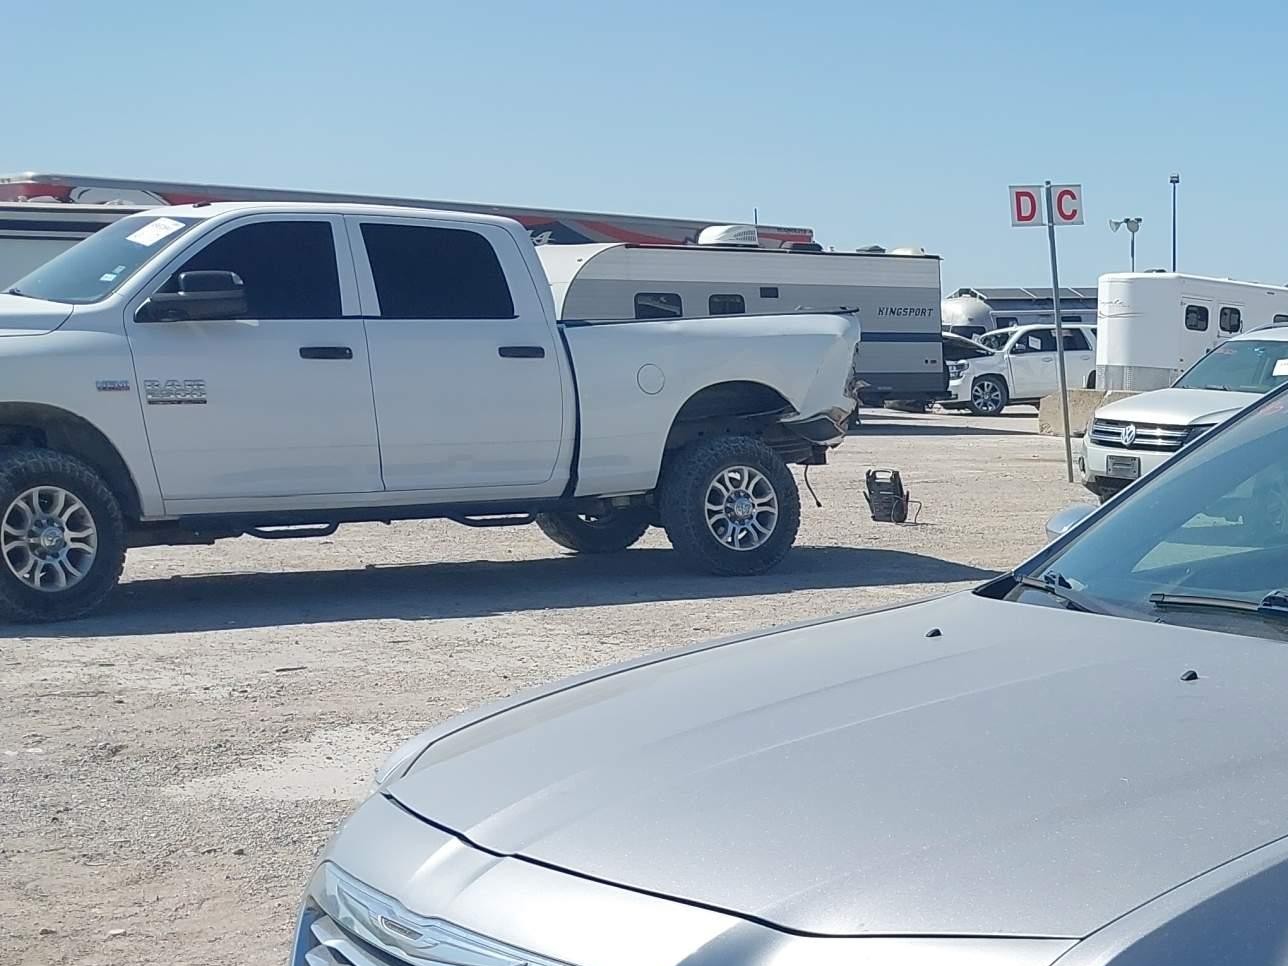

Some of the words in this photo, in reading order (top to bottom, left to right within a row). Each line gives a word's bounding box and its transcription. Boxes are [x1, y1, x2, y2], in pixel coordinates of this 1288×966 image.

[1015, 191, 1037, 222] D
[1056, 189, 1078, 221] C
[877, 306, 934, 317] KINGSPORT
